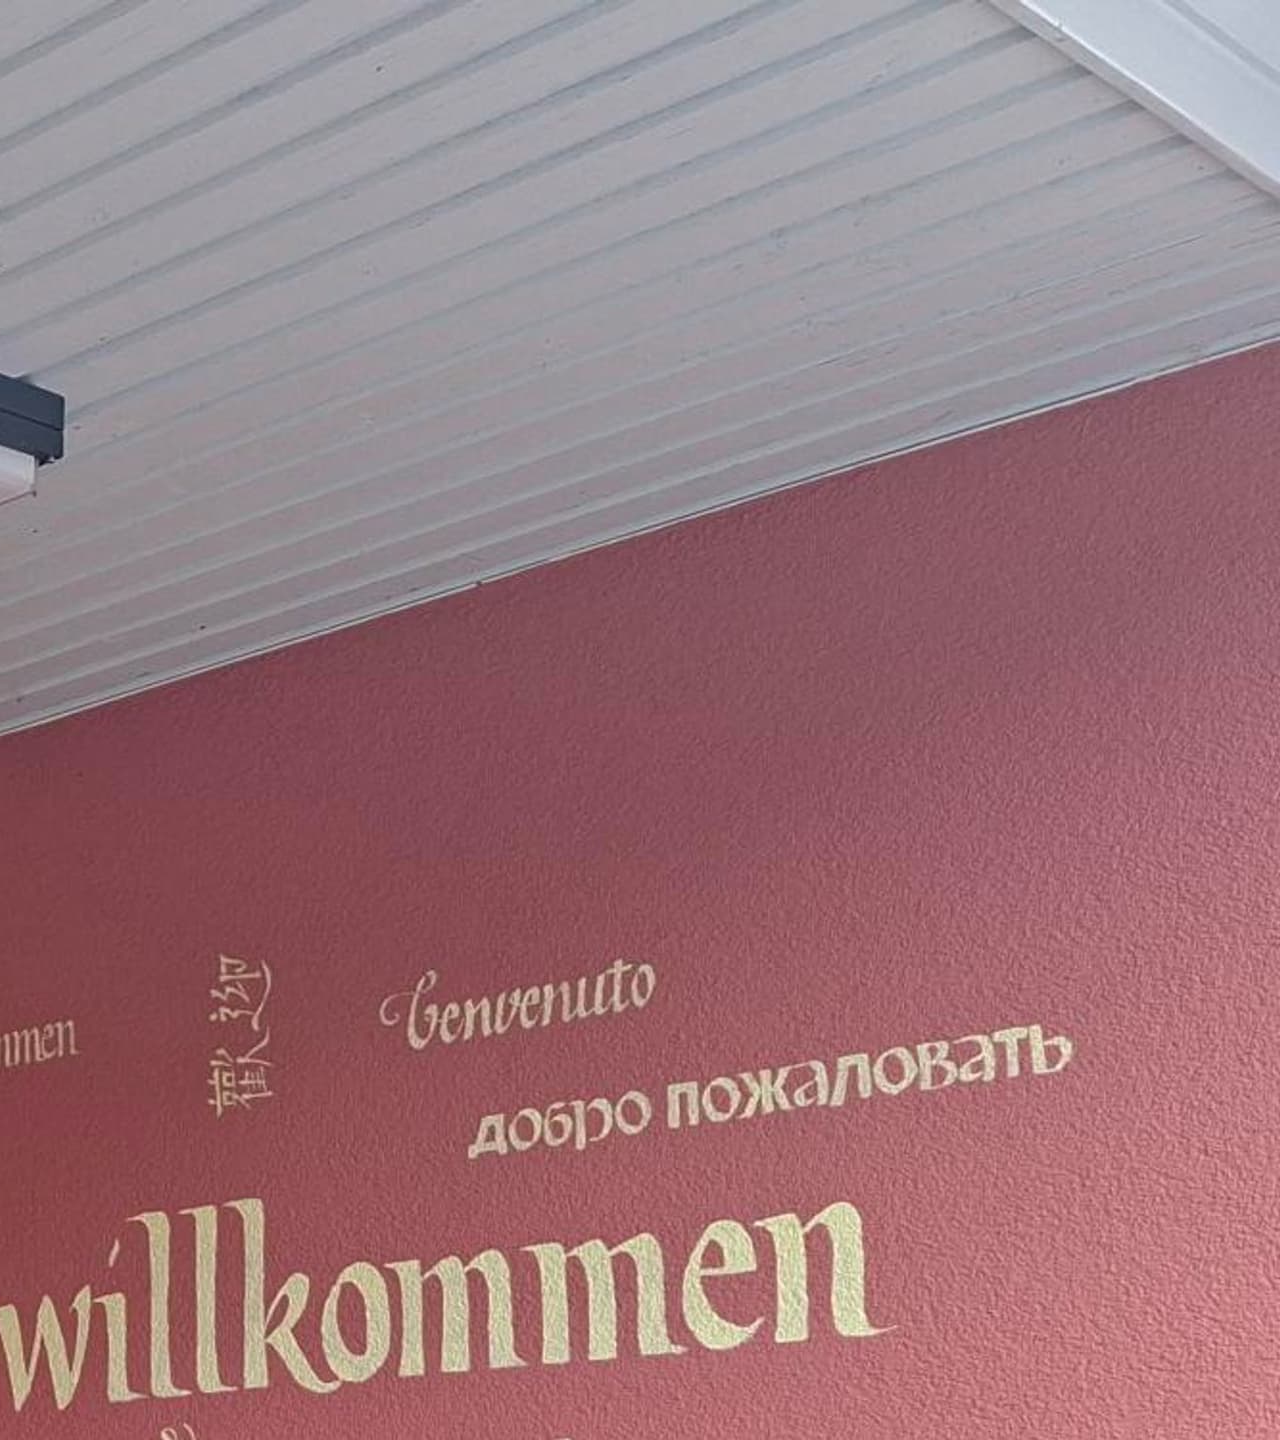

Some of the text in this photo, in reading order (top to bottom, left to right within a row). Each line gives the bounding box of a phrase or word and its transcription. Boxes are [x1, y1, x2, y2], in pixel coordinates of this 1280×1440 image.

[380, 959, 656, 1049] benvenuto
[468, 1024, 1074, 1159] добро пожаловать
